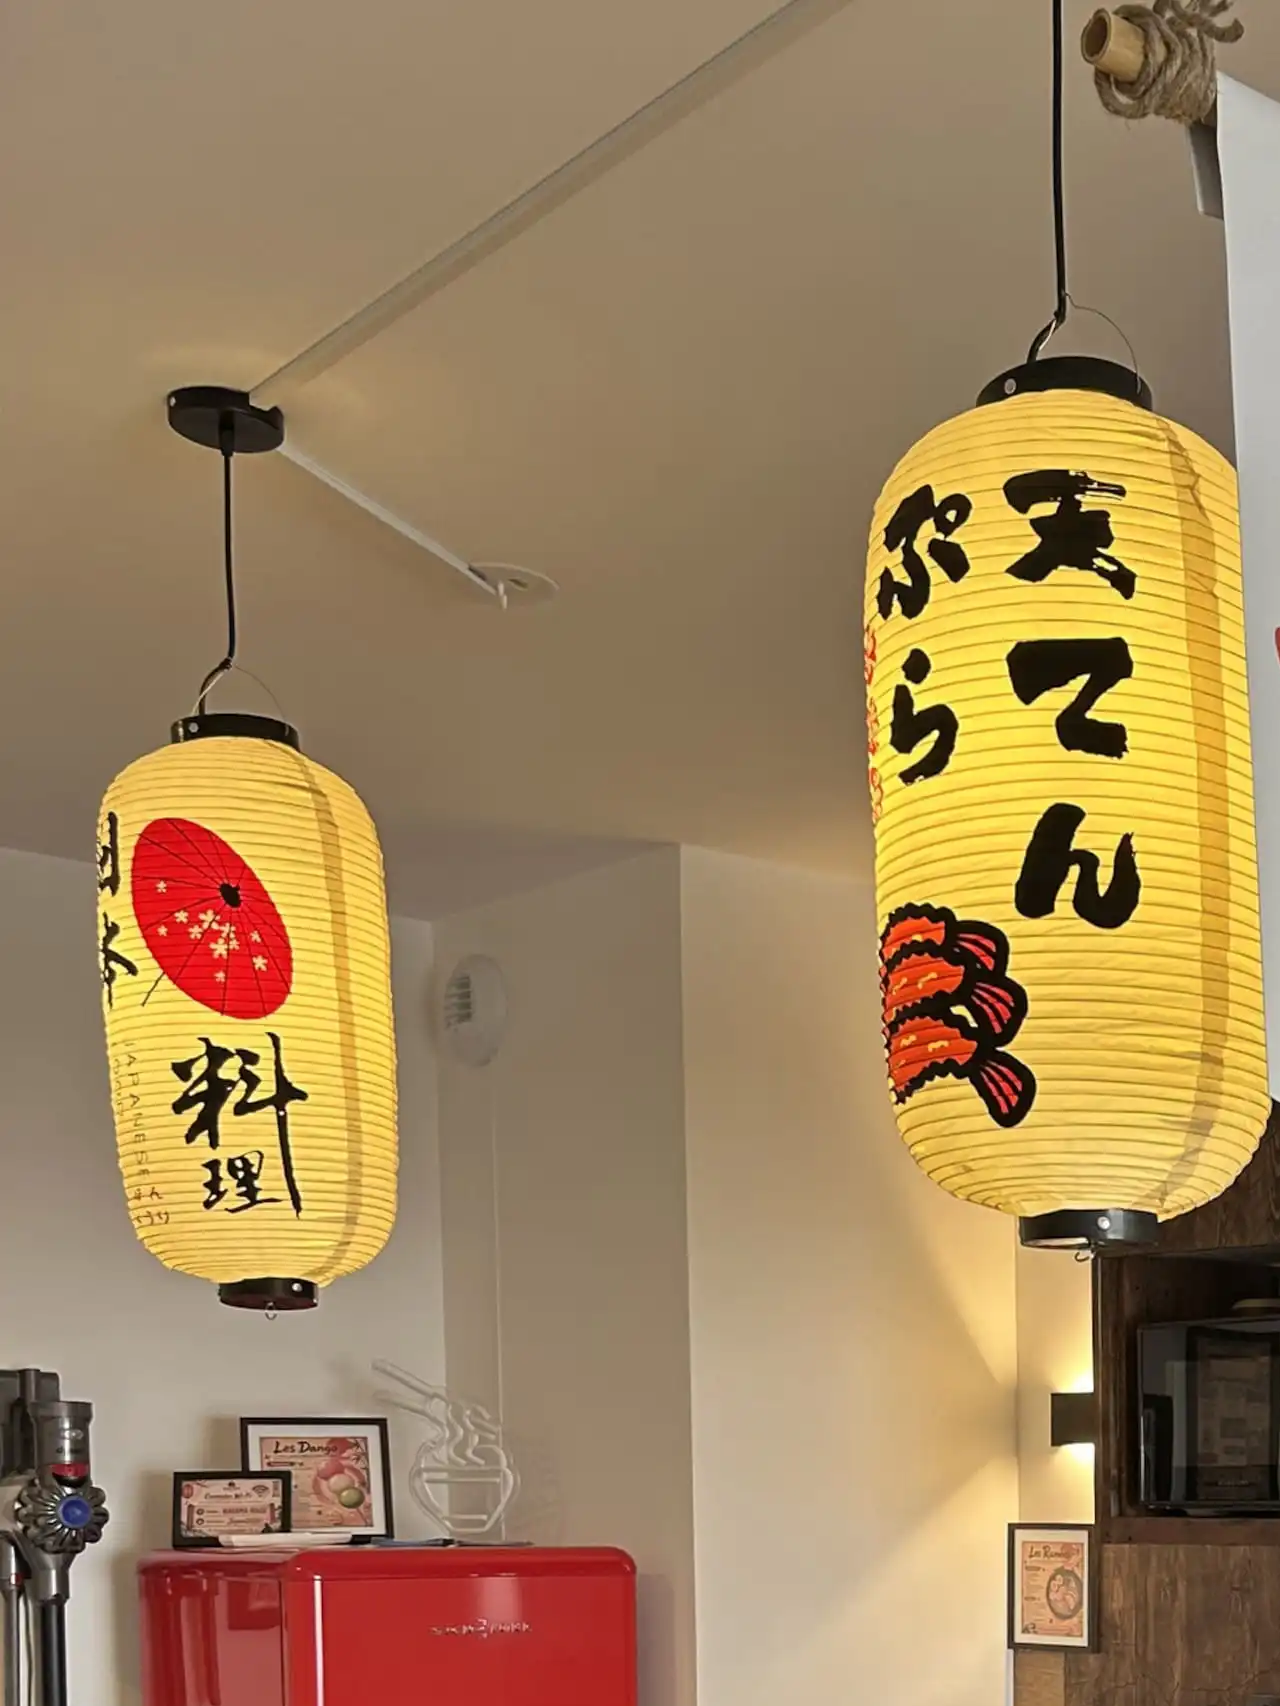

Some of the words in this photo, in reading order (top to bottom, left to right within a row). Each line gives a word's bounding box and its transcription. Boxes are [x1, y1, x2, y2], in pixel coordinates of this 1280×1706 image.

[171, 1031, 309, 1220] 料理
[273, 1440, 296, 1454] Les
[297, 1440, 339, 1456] Dango
